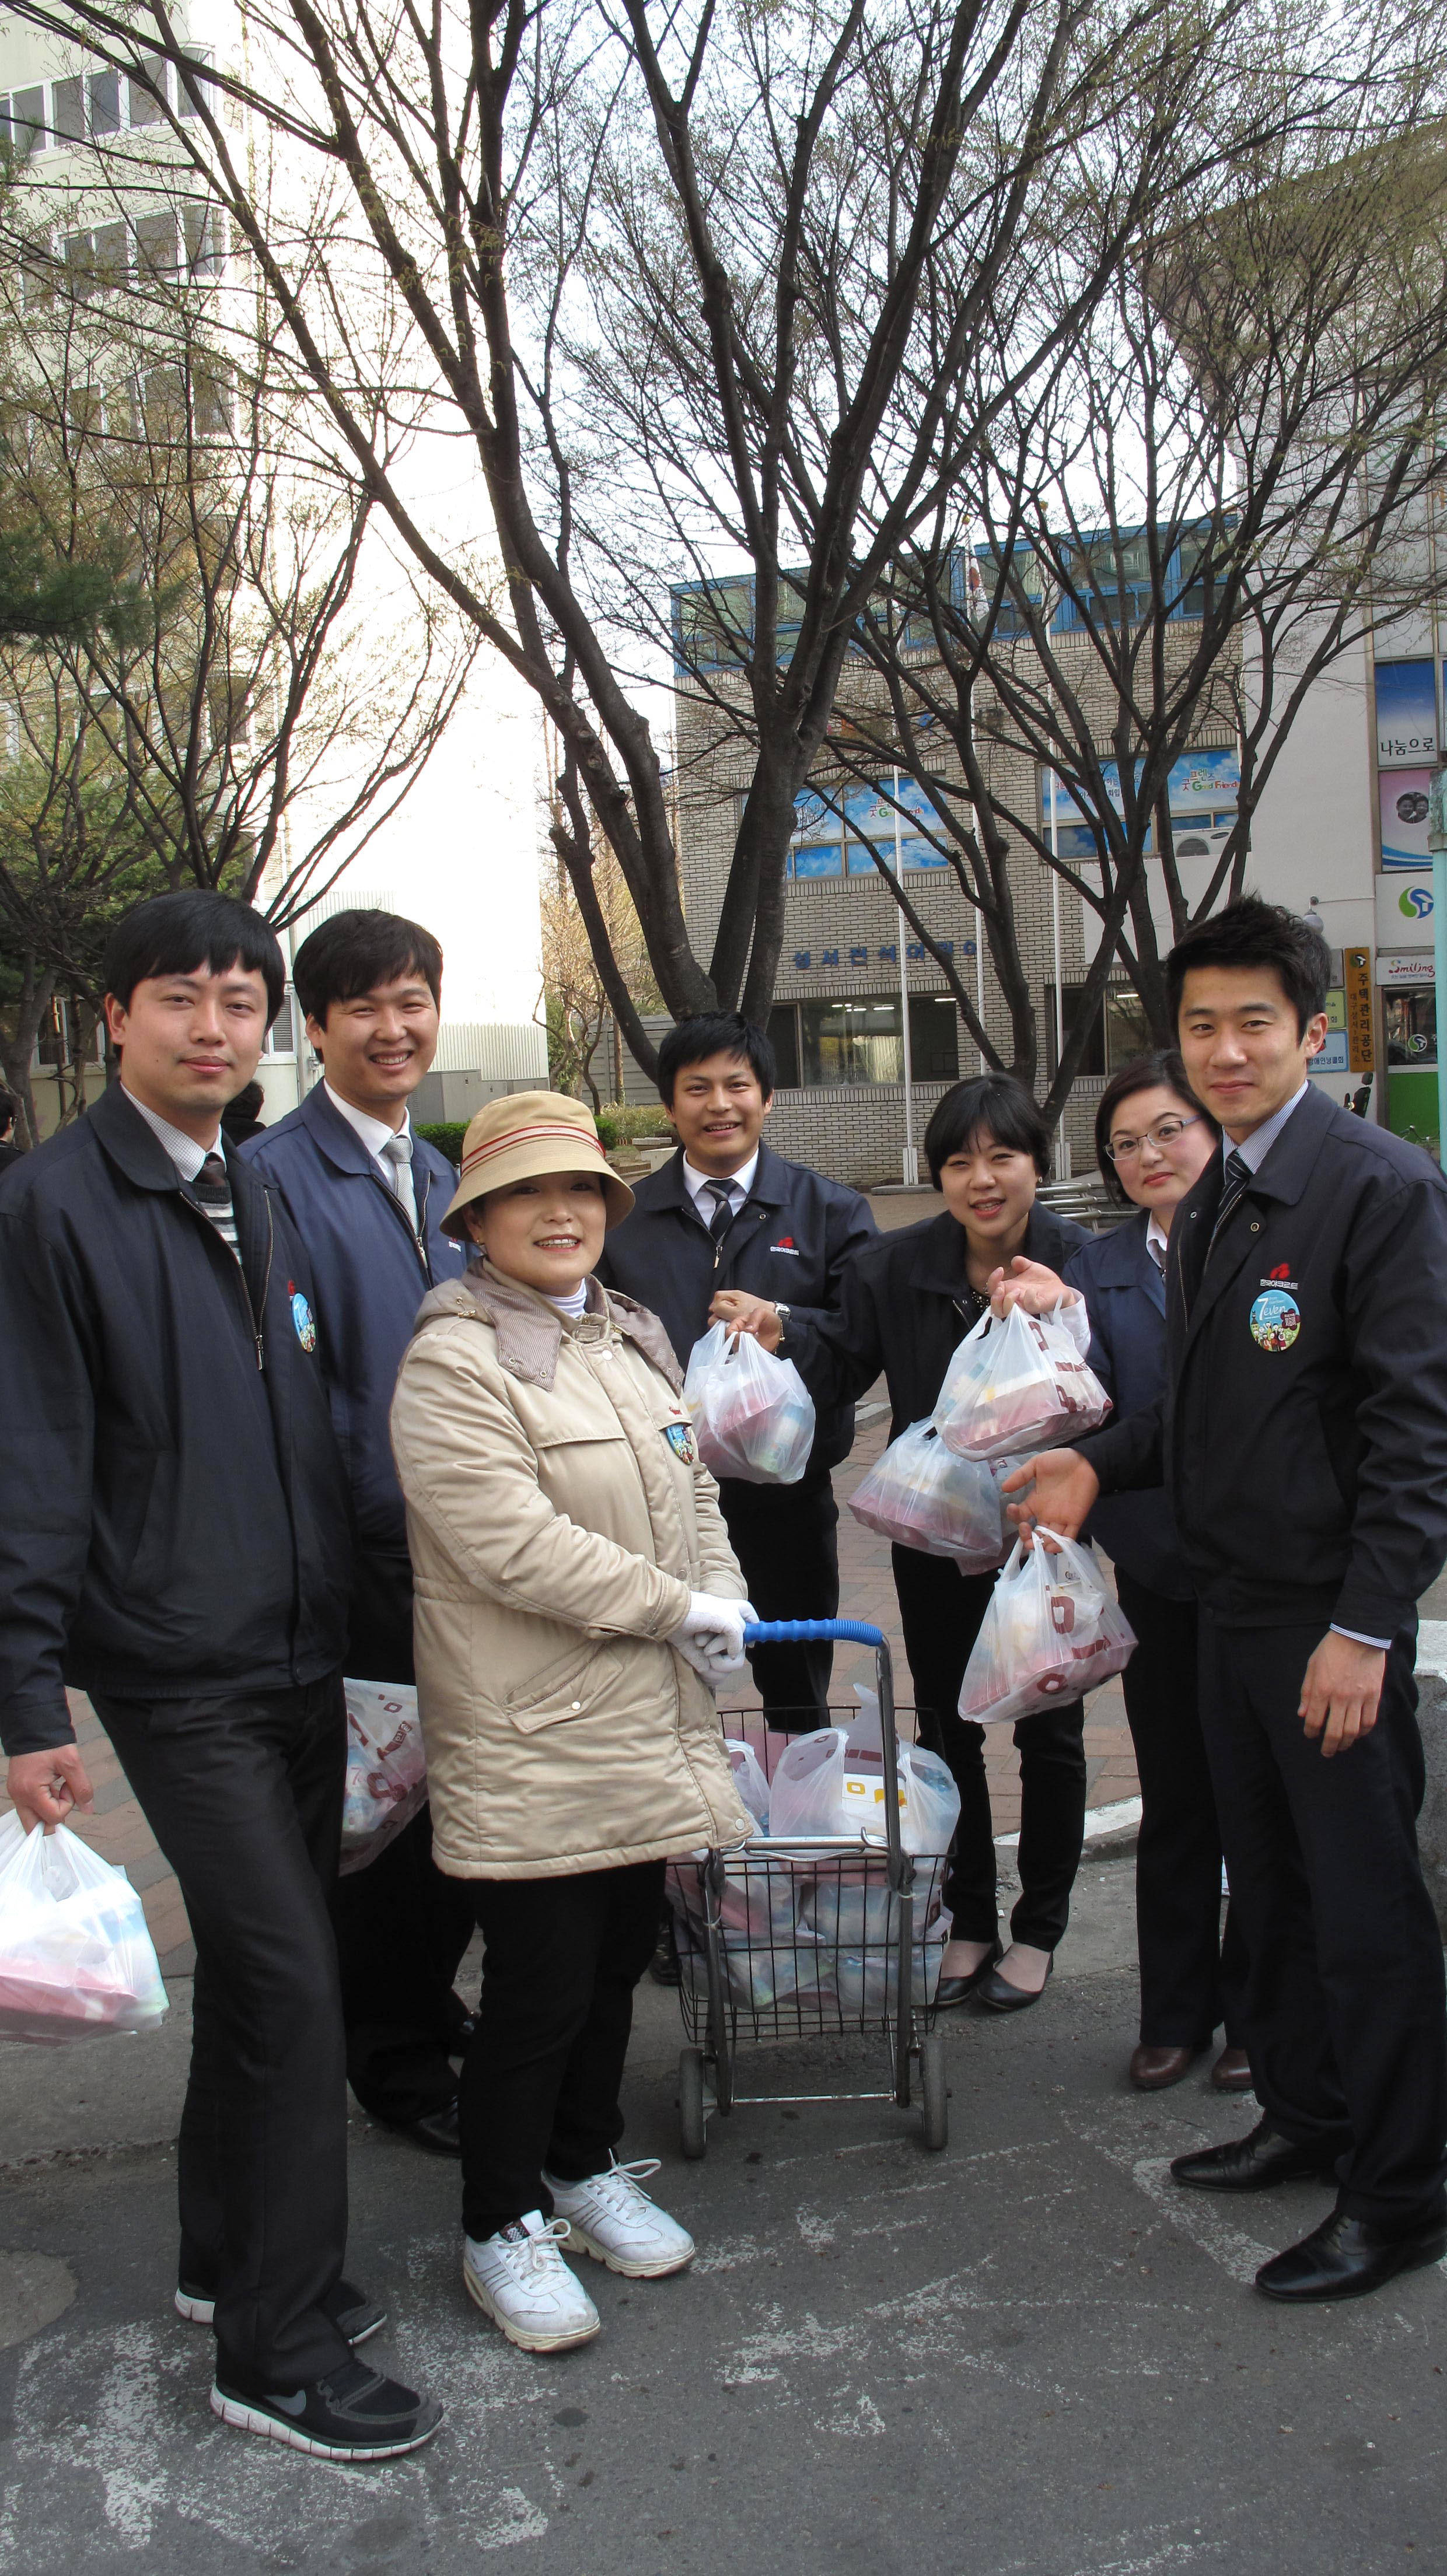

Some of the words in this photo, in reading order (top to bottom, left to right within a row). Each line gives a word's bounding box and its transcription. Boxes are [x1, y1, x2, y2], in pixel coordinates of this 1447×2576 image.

[1380, 737, 1435, 757] 나눔으로
[1389, 959, 1435, 978] Smiling
[1358, 973, 1372, 1062] 주택관리공단
